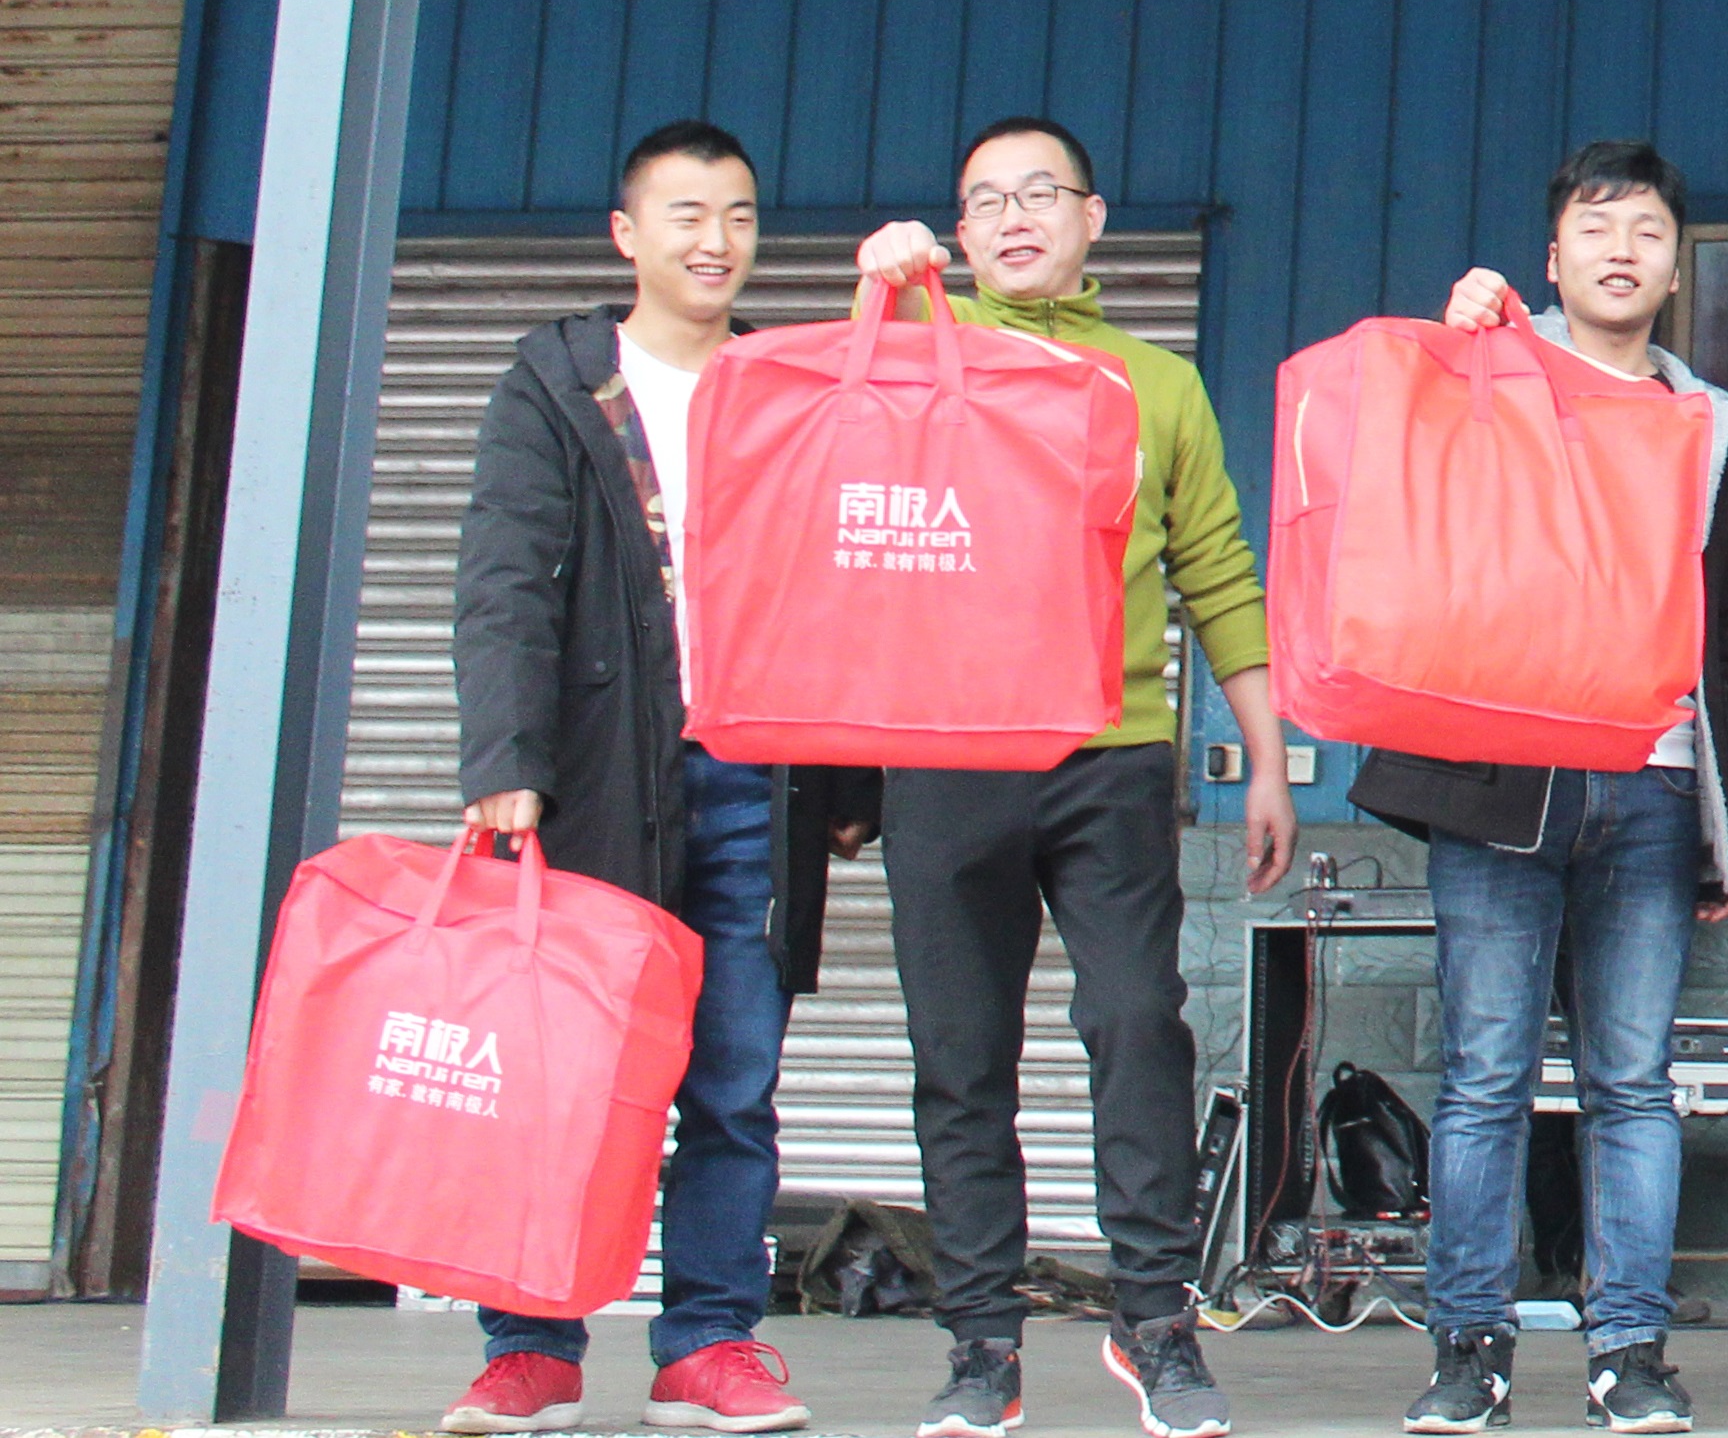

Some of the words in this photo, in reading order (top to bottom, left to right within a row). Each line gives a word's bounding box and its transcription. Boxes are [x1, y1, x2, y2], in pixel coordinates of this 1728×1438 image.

[838, 482, 970, 528] 南极人
[379, 1011, 503, 1075] 南极人
